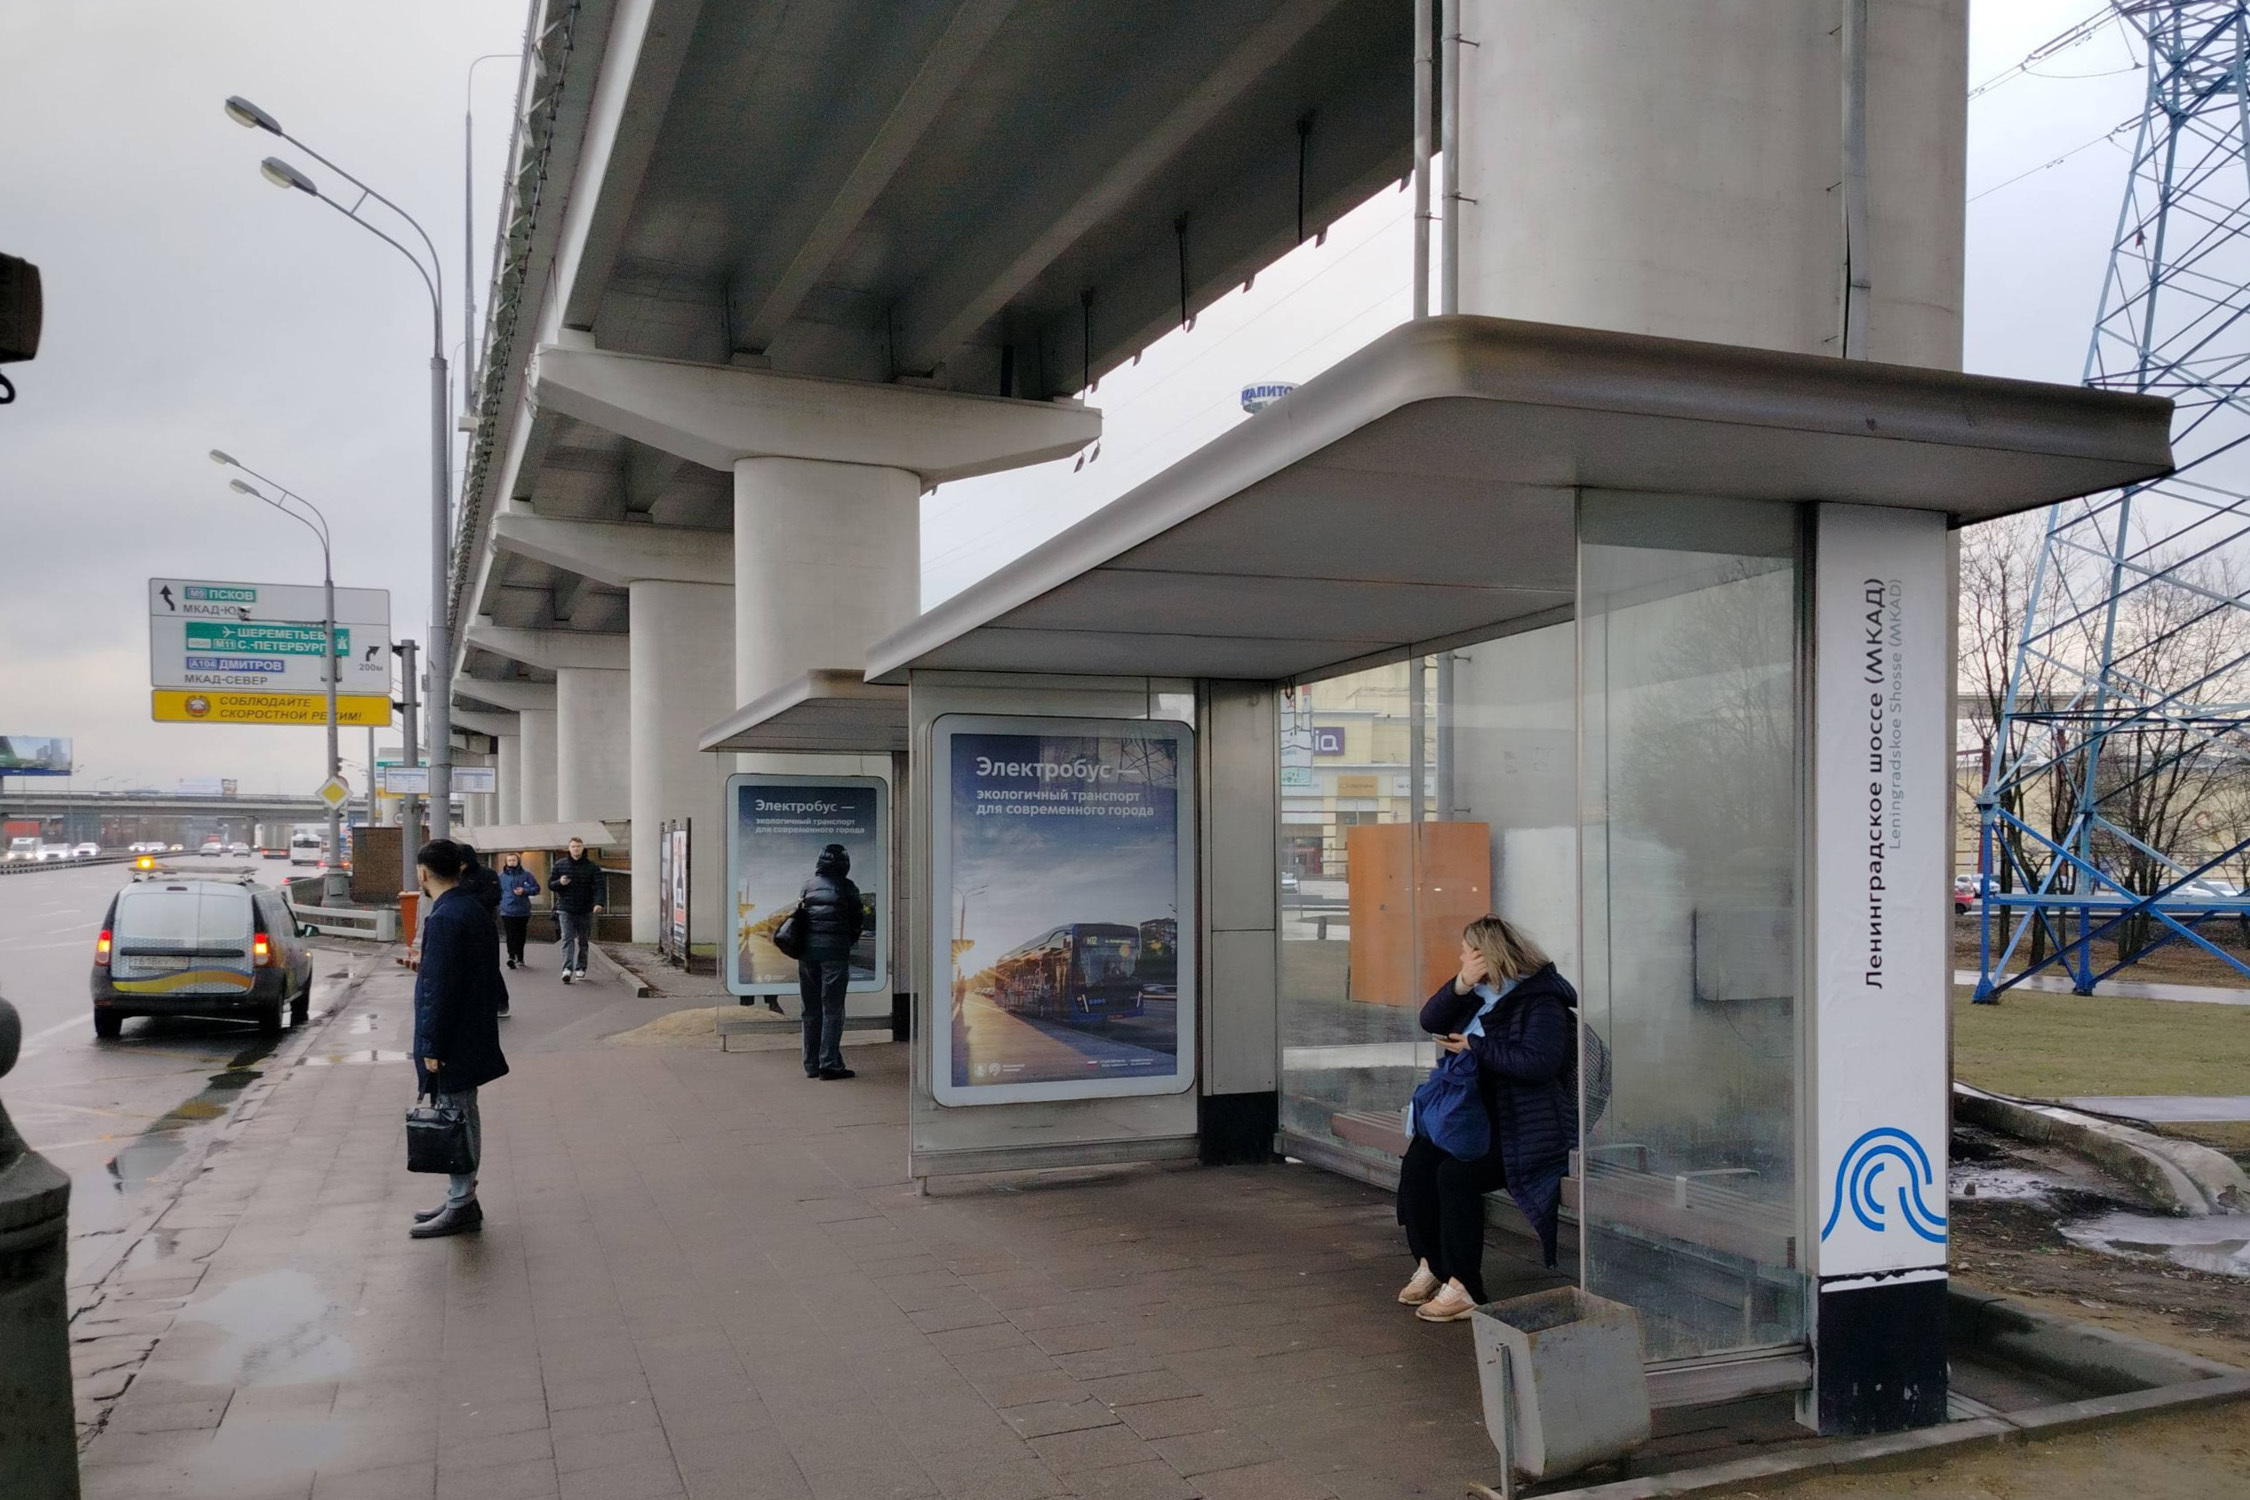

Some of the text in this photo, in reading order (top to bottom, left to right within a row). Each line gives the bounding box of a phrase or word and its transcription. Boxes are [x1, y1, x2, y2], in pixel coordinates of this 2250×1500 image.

[209, 589, 255, 601] ПСКОВ
[183, 604, 246, 616] МКАД-Ю
[190, 660, 283, 672] А104 ДМИТРОВ
[358, 663, 384, 672] 200м
[184, 674, 268, 685] МКАД-СЕВЕР
[219, 695, 312, 708] СОБЛЮДАЙТЕ
[219, 708, 363, 721] СКОРОСТНОЙ РЕИМ!
[1889, 578, 1905, 850] Leningradskoe Shosse (MKAD)
[975, 756, 1112, 783] Электробус
[1864, 577, 1886, 990] Ленинградское шоссе (МКАД)
[976, 788, 1141, 804] экологичный транспорт
[755, 799, 838, 814] Электробус
[976, 803, 1155, 818] для современного города
[755, 826, 772, 834] для
